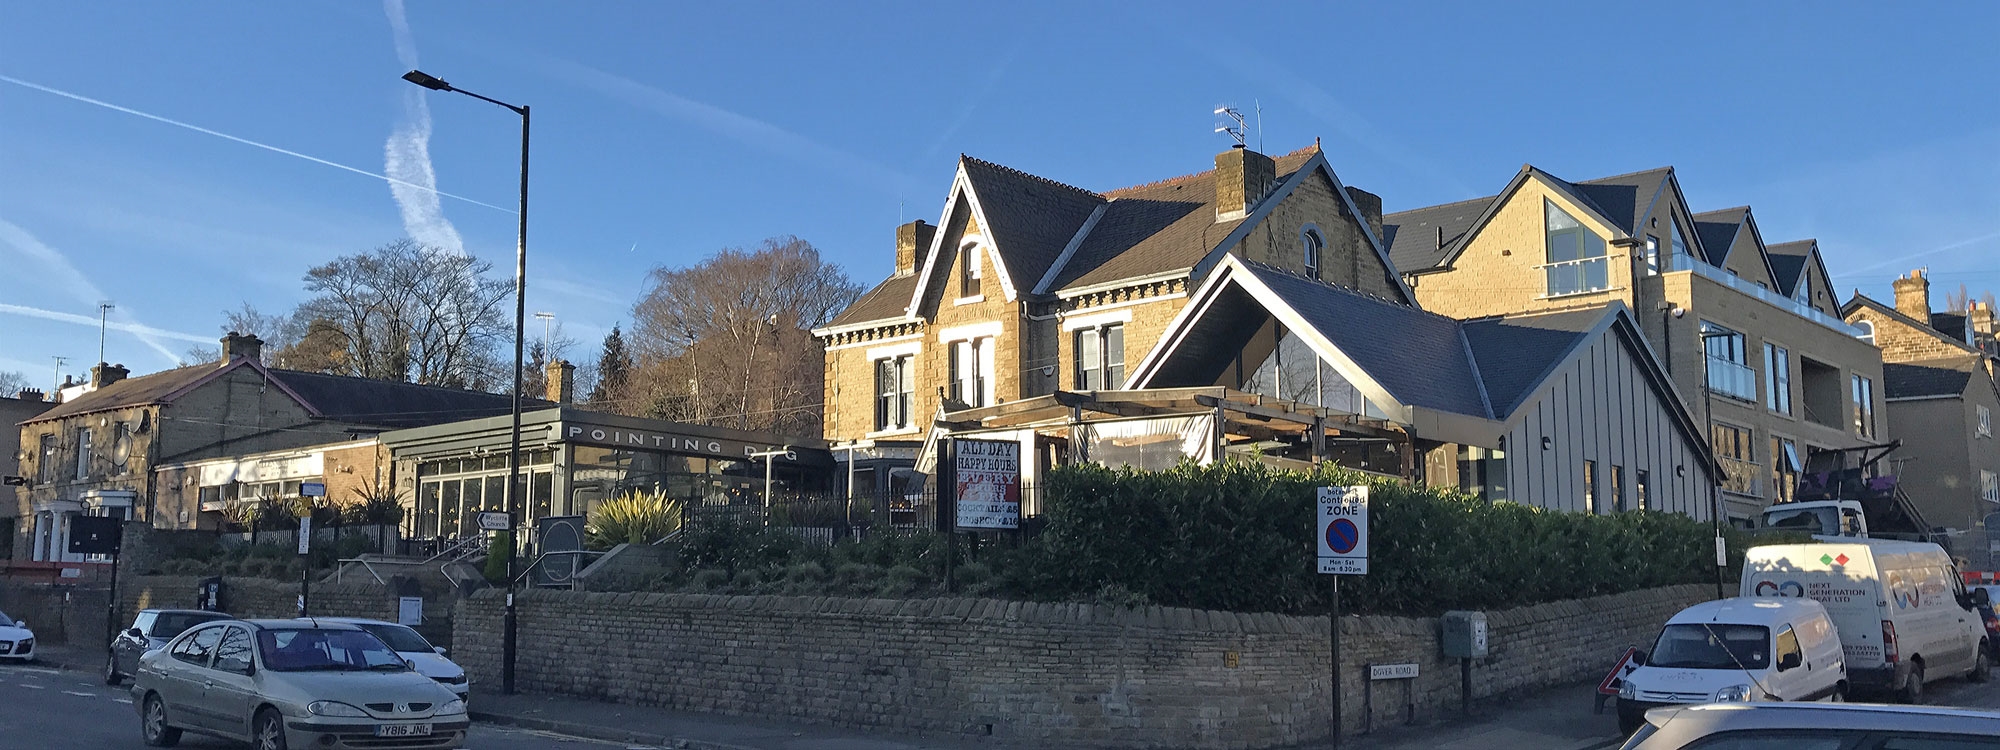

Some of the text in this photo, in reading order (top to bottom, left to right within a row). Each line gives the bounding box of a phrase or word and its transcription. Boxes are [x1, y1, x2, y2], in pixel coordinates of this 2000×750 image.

[568, 426, 797, 461] POINTING DG
[961, 441, 1013, 457] ALL DAY
[958, 457, 1017, 472] HAPPY HOURS
[958, 472, 1017, 485] EVERY
[1320, 495, 1366, 504] Controlled
[958, 503, 1005, 514] COCKTAILS
[1326, 506, 1359, 516] ZONE
[957, 515, 1001, 525] PROSECCO
[1808, 582, 1832, 590] NEXT
[1809, 589, 1866, 597] GENERATION
[1373, 666, 1412, 677] DOVER ROAD
[384, 725, 428, 736] Y816 JNL
